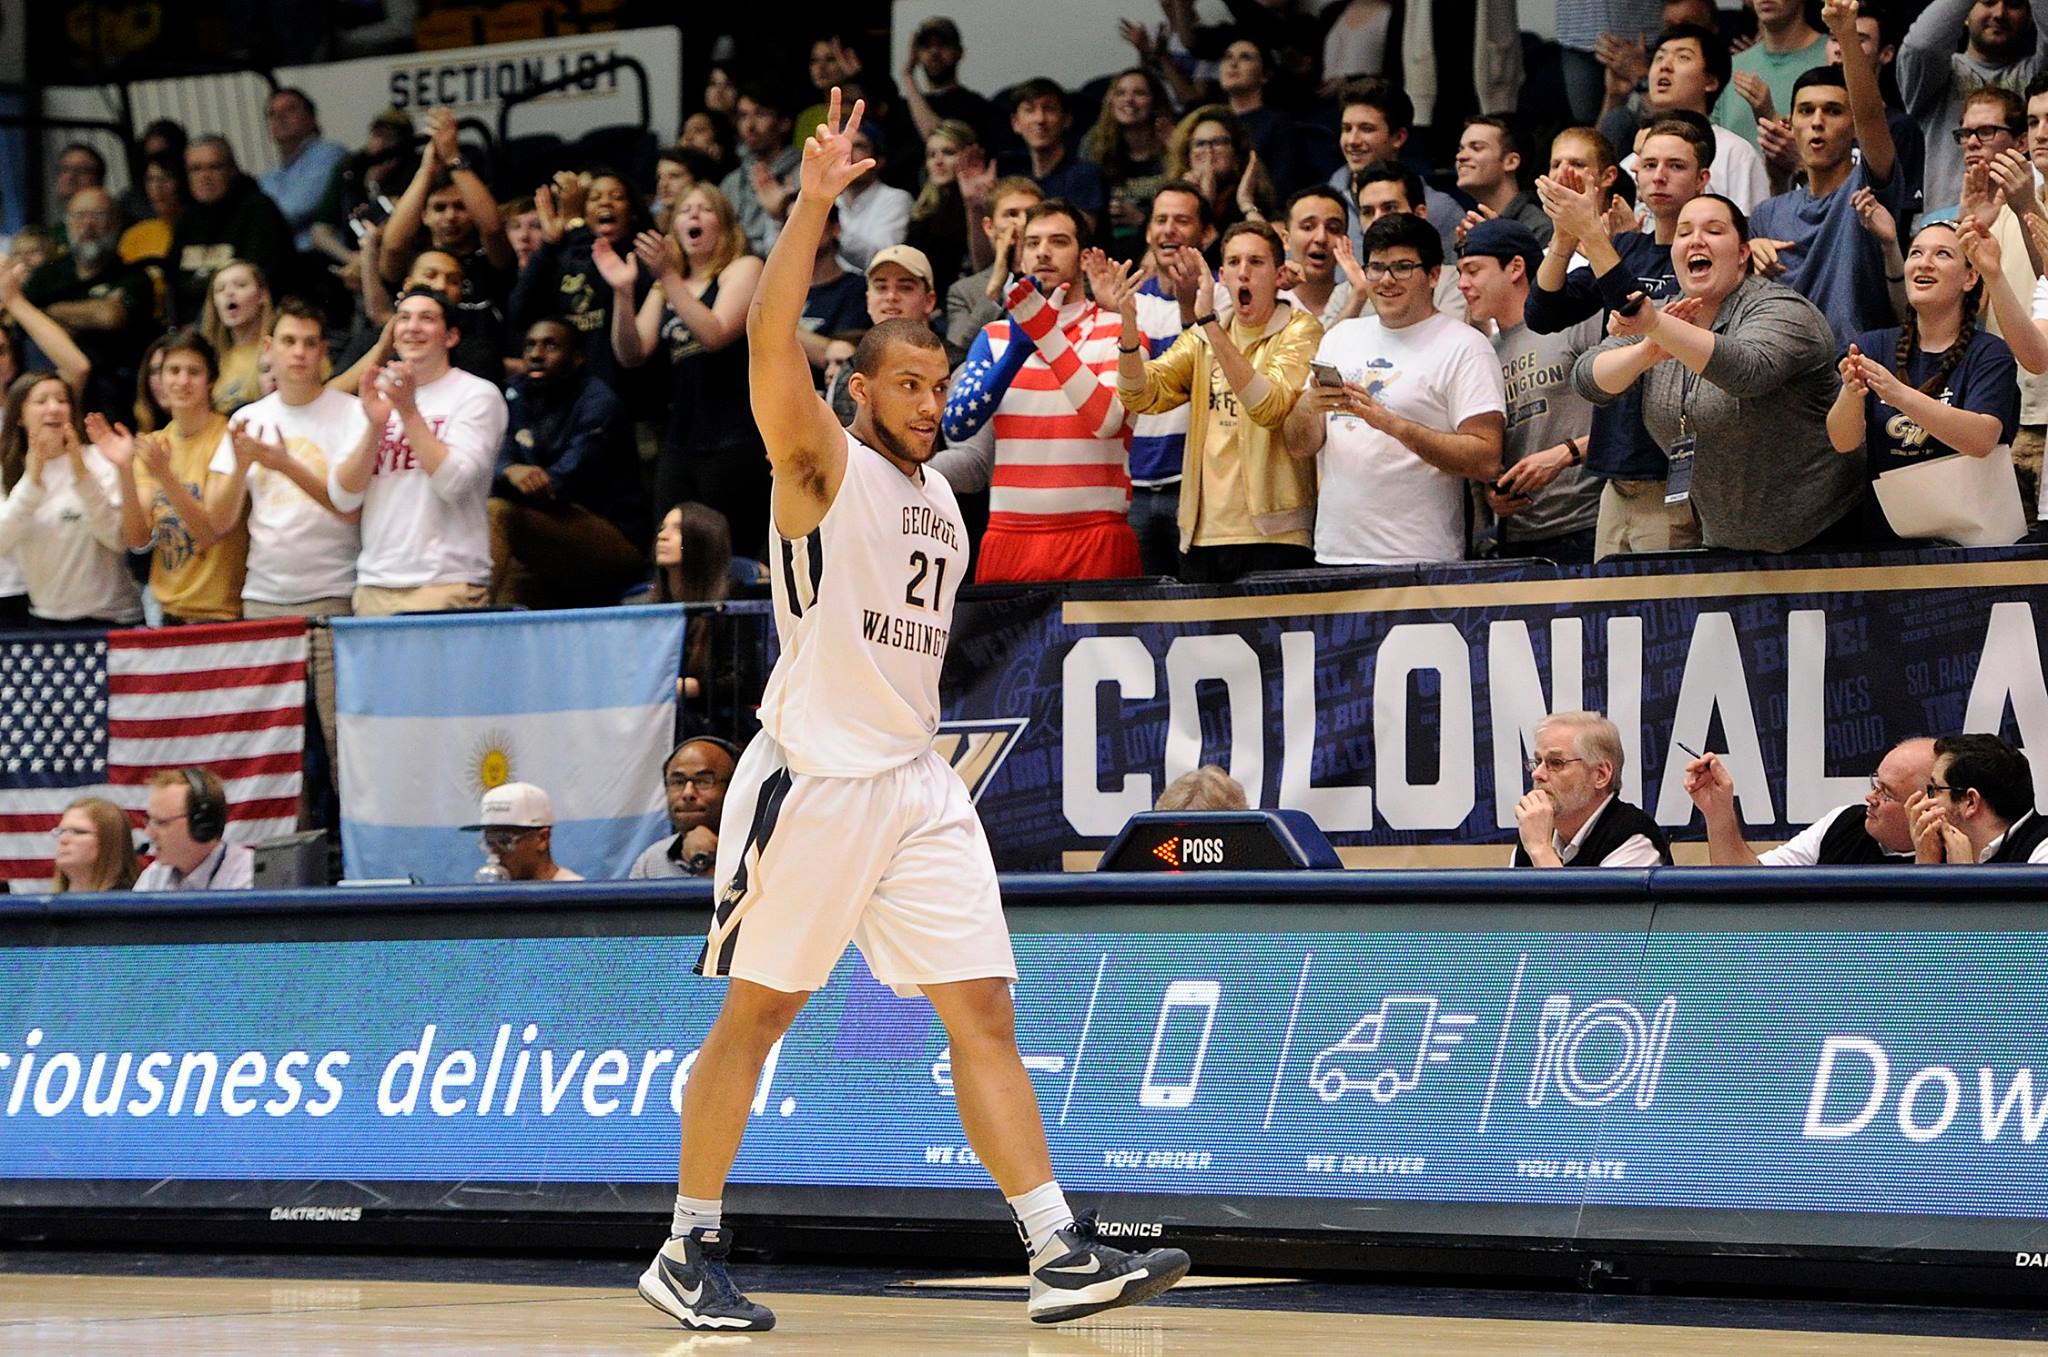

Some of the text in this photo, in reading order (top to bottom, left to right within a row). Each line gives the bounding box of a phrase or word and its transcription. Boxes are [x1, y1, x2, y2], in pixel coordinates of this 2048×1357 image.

[389, 49, 618, 109] SECTION 101
[905, 550, 946, 612] 21
[1063, 609, 1885, 837] COLONIAL
[1182, 838, 1224, 864] POSS
[0, 1027, 350, 1118] iousness
[1104, 1150, 1212, 1169] YOU ORDER
[1306, 1155, 1424, 1175] WE DELIVER
[1516, 1160, 1627, 1179] YOU PLATE
[270, 1206, 362, 1221] DAKTRONICS
[1096, 1222, 1163, 1237] RONICS
[2016, 1252, 2048, 1268] DA
